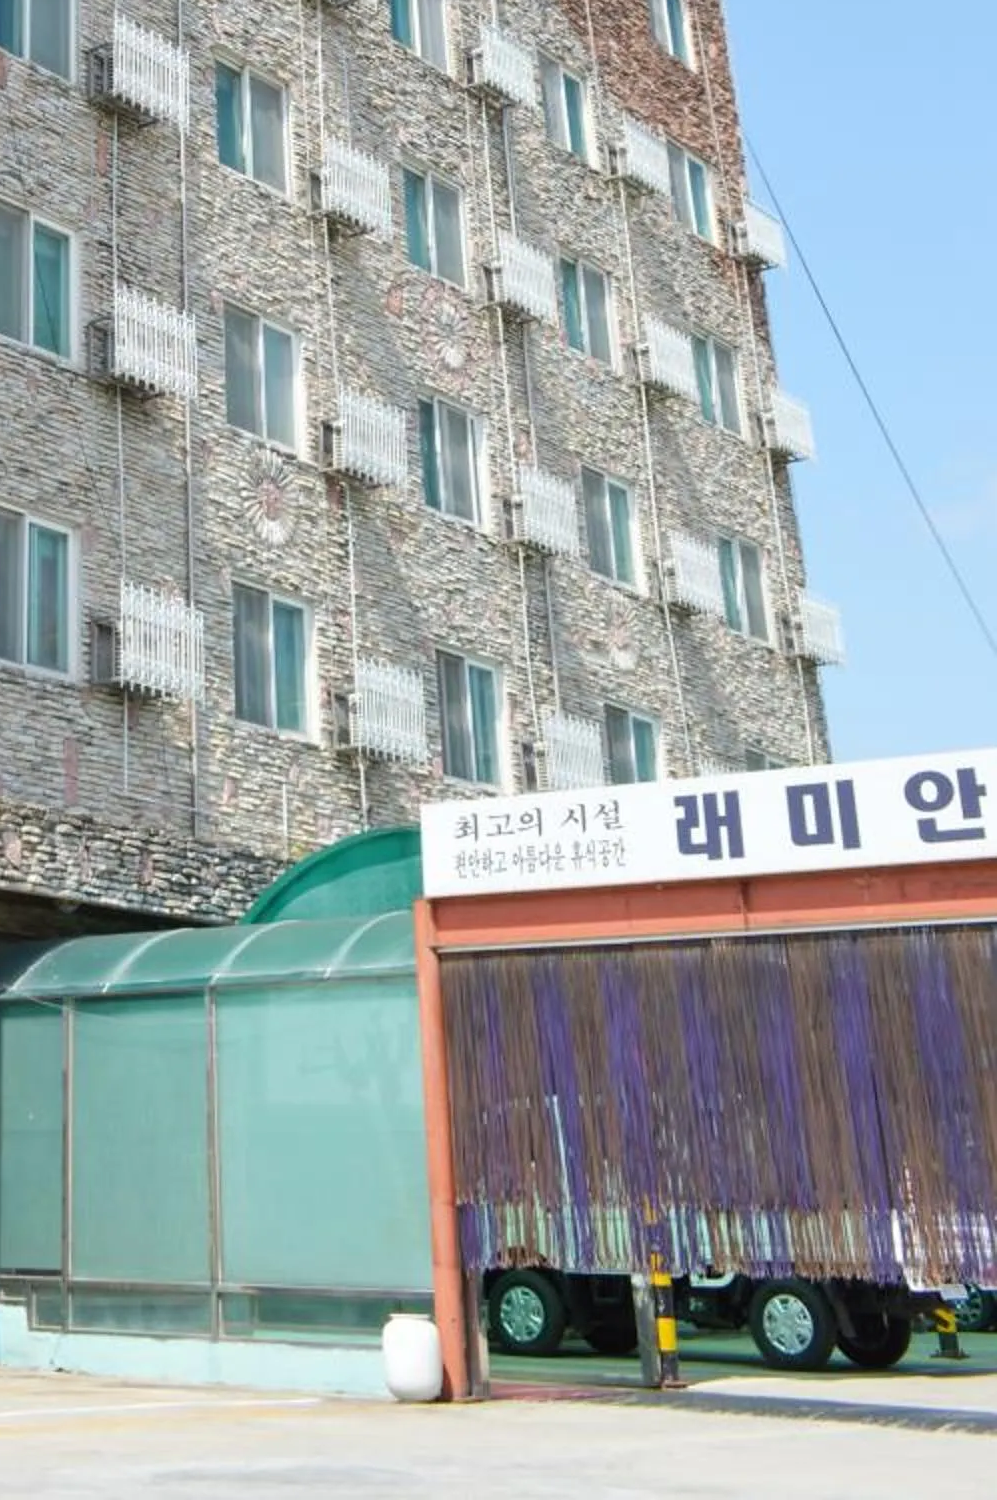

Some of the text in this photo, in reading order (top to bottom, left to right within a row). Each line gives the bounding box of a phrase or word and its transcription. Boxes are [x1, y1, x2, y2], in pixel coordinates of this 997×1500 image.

[455, 799, 626, 842] 최고의 시설
[673, 767, 988, 861] 래미안
[512, 841, 566, 875] 아름다운
[570, 836, 627, 871] 휴식공간
